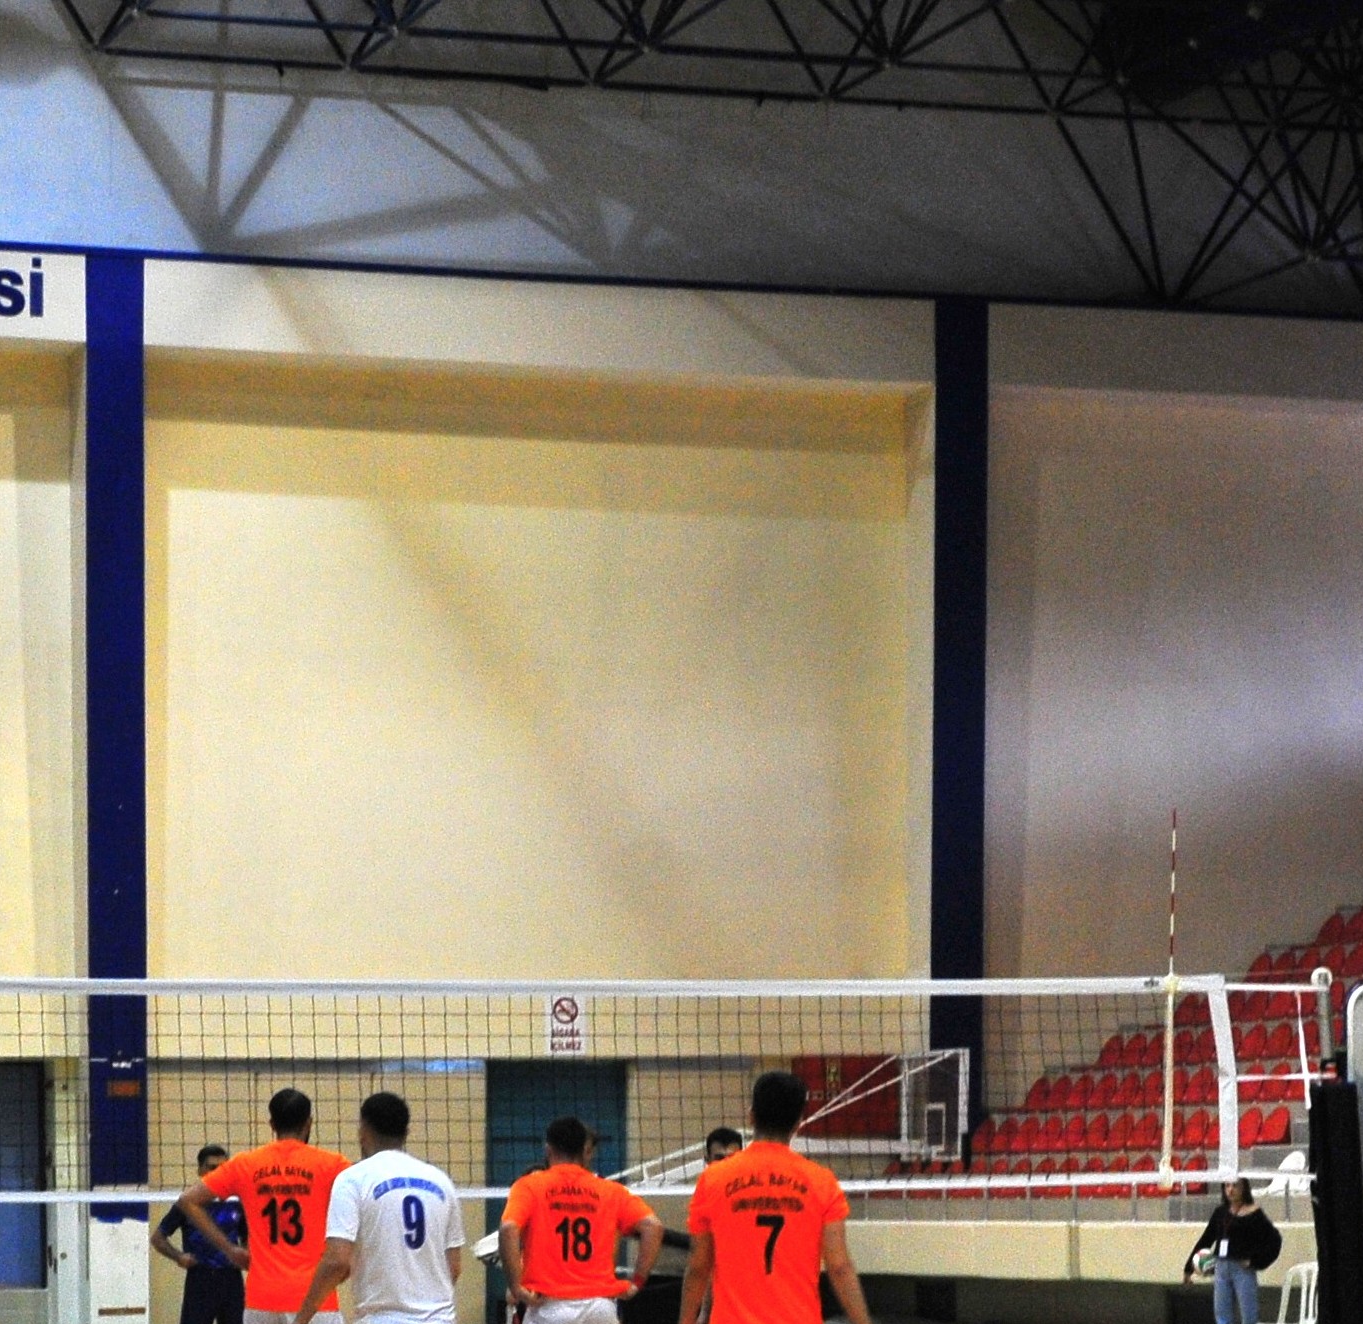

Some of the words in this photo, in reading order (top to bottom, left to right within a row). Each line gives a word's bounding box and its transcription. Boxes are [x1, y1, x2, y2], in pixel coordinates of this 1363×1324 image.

[261, 1197, 304, 1246] 13
[402, 1195, 425, 1250] 9
[556, 1216, 593, 1262] 18
[756, 1214, 785, 1275] 7
